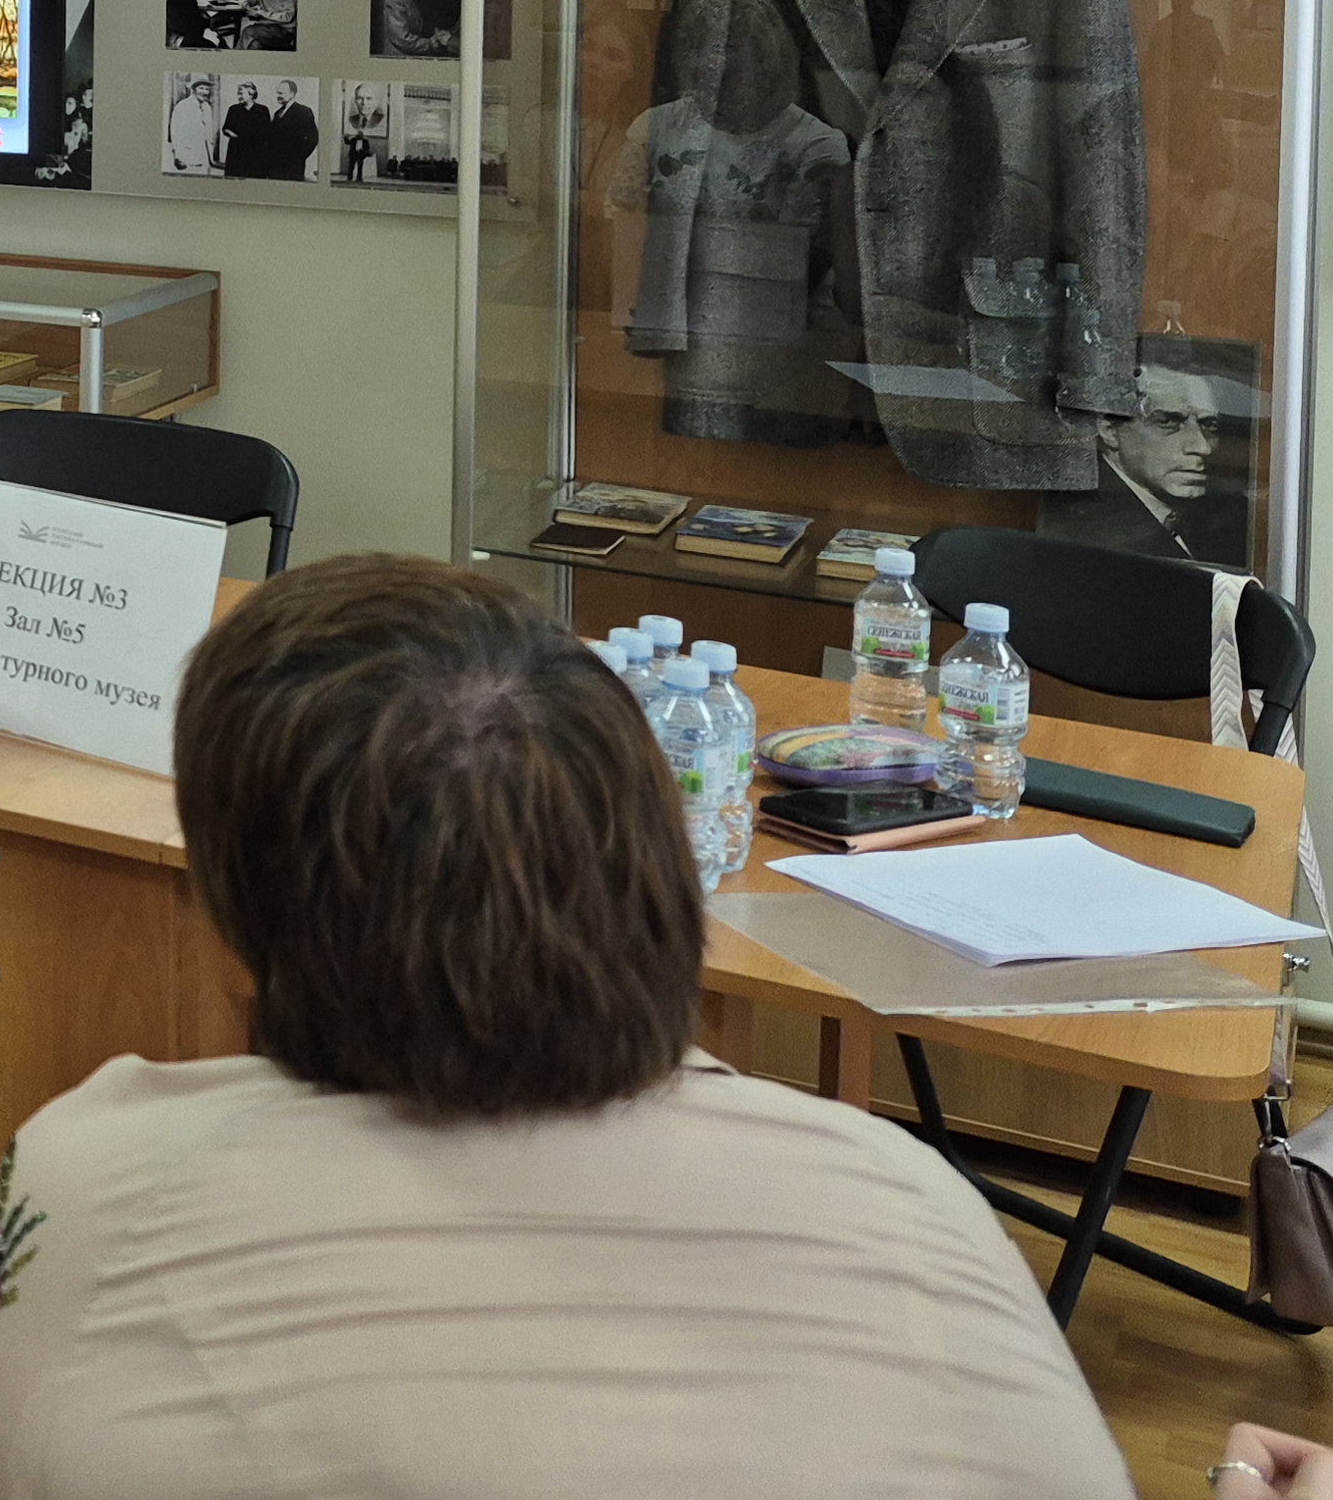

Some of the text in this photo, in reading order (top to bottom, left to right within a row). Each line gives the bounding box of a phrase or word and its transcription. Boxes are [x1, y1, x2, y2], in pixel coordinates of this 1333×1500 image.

[88, 582, 129, 610] №3
[4, 605, 86, 644] Зал №5
[867, 625, 921, 641] СЕНЕЖСКАЯ
[94, 678, 162, 710] музея
